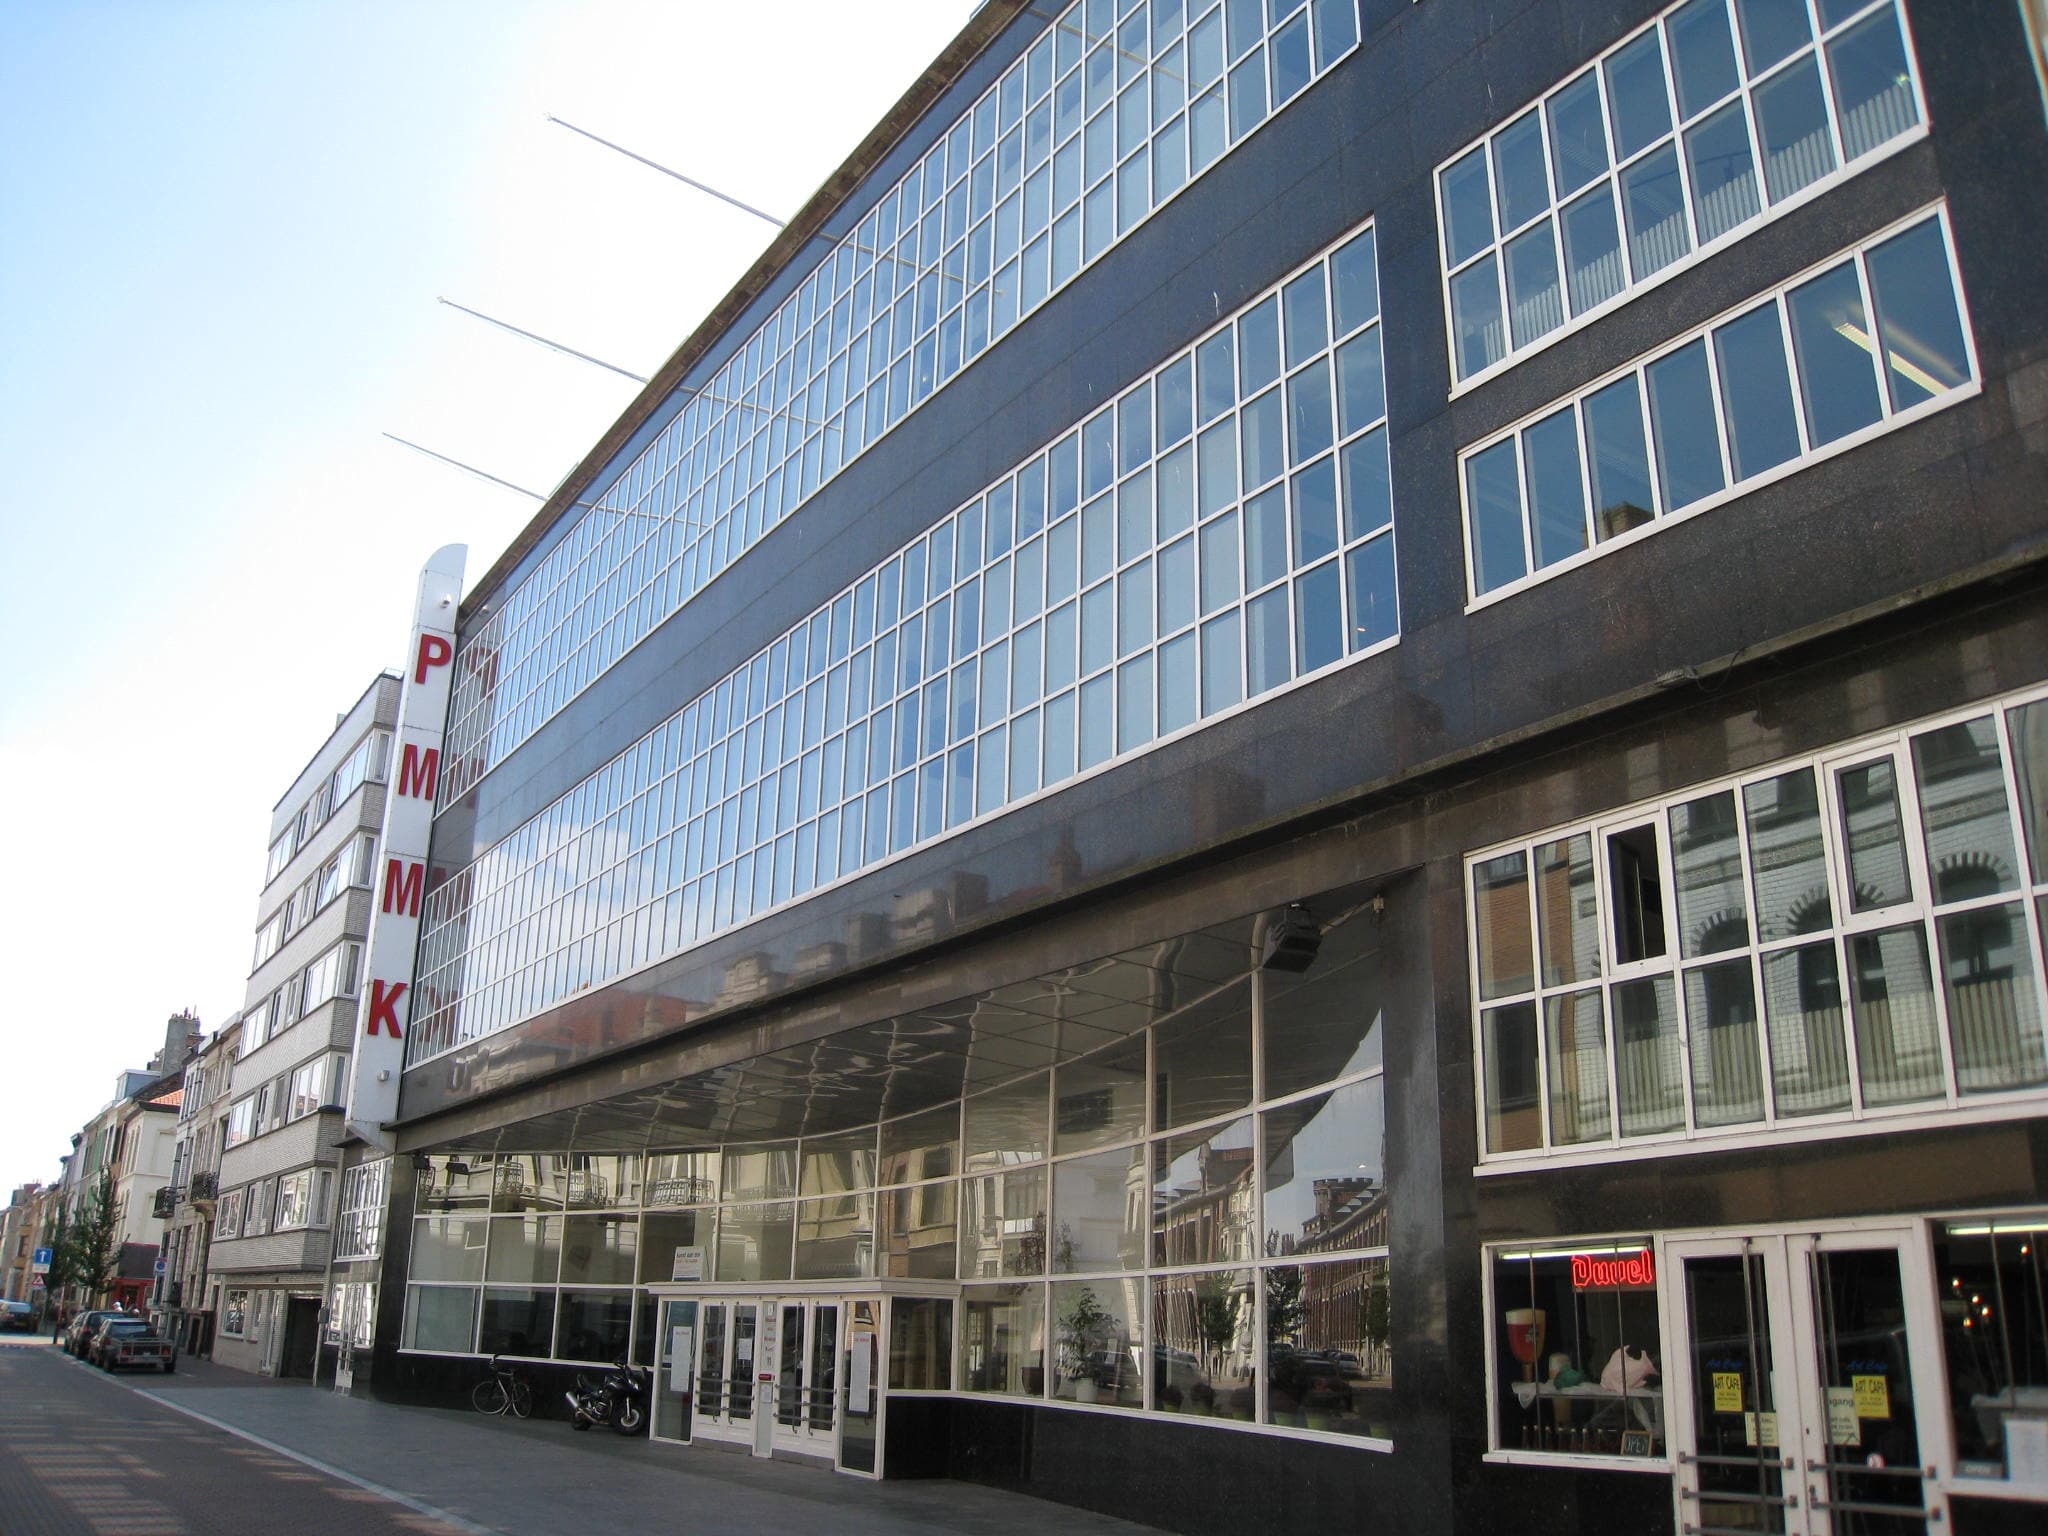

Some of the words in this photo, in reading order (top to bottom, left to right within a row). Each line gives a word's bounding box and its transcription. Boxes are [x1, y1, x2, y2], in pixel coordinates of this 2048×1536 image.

[1571, 1250, 1652, 1286] Duvel
[1714, 1375, 1724, 1389] ART
[1855, 1379, 1866, 1393] ART
